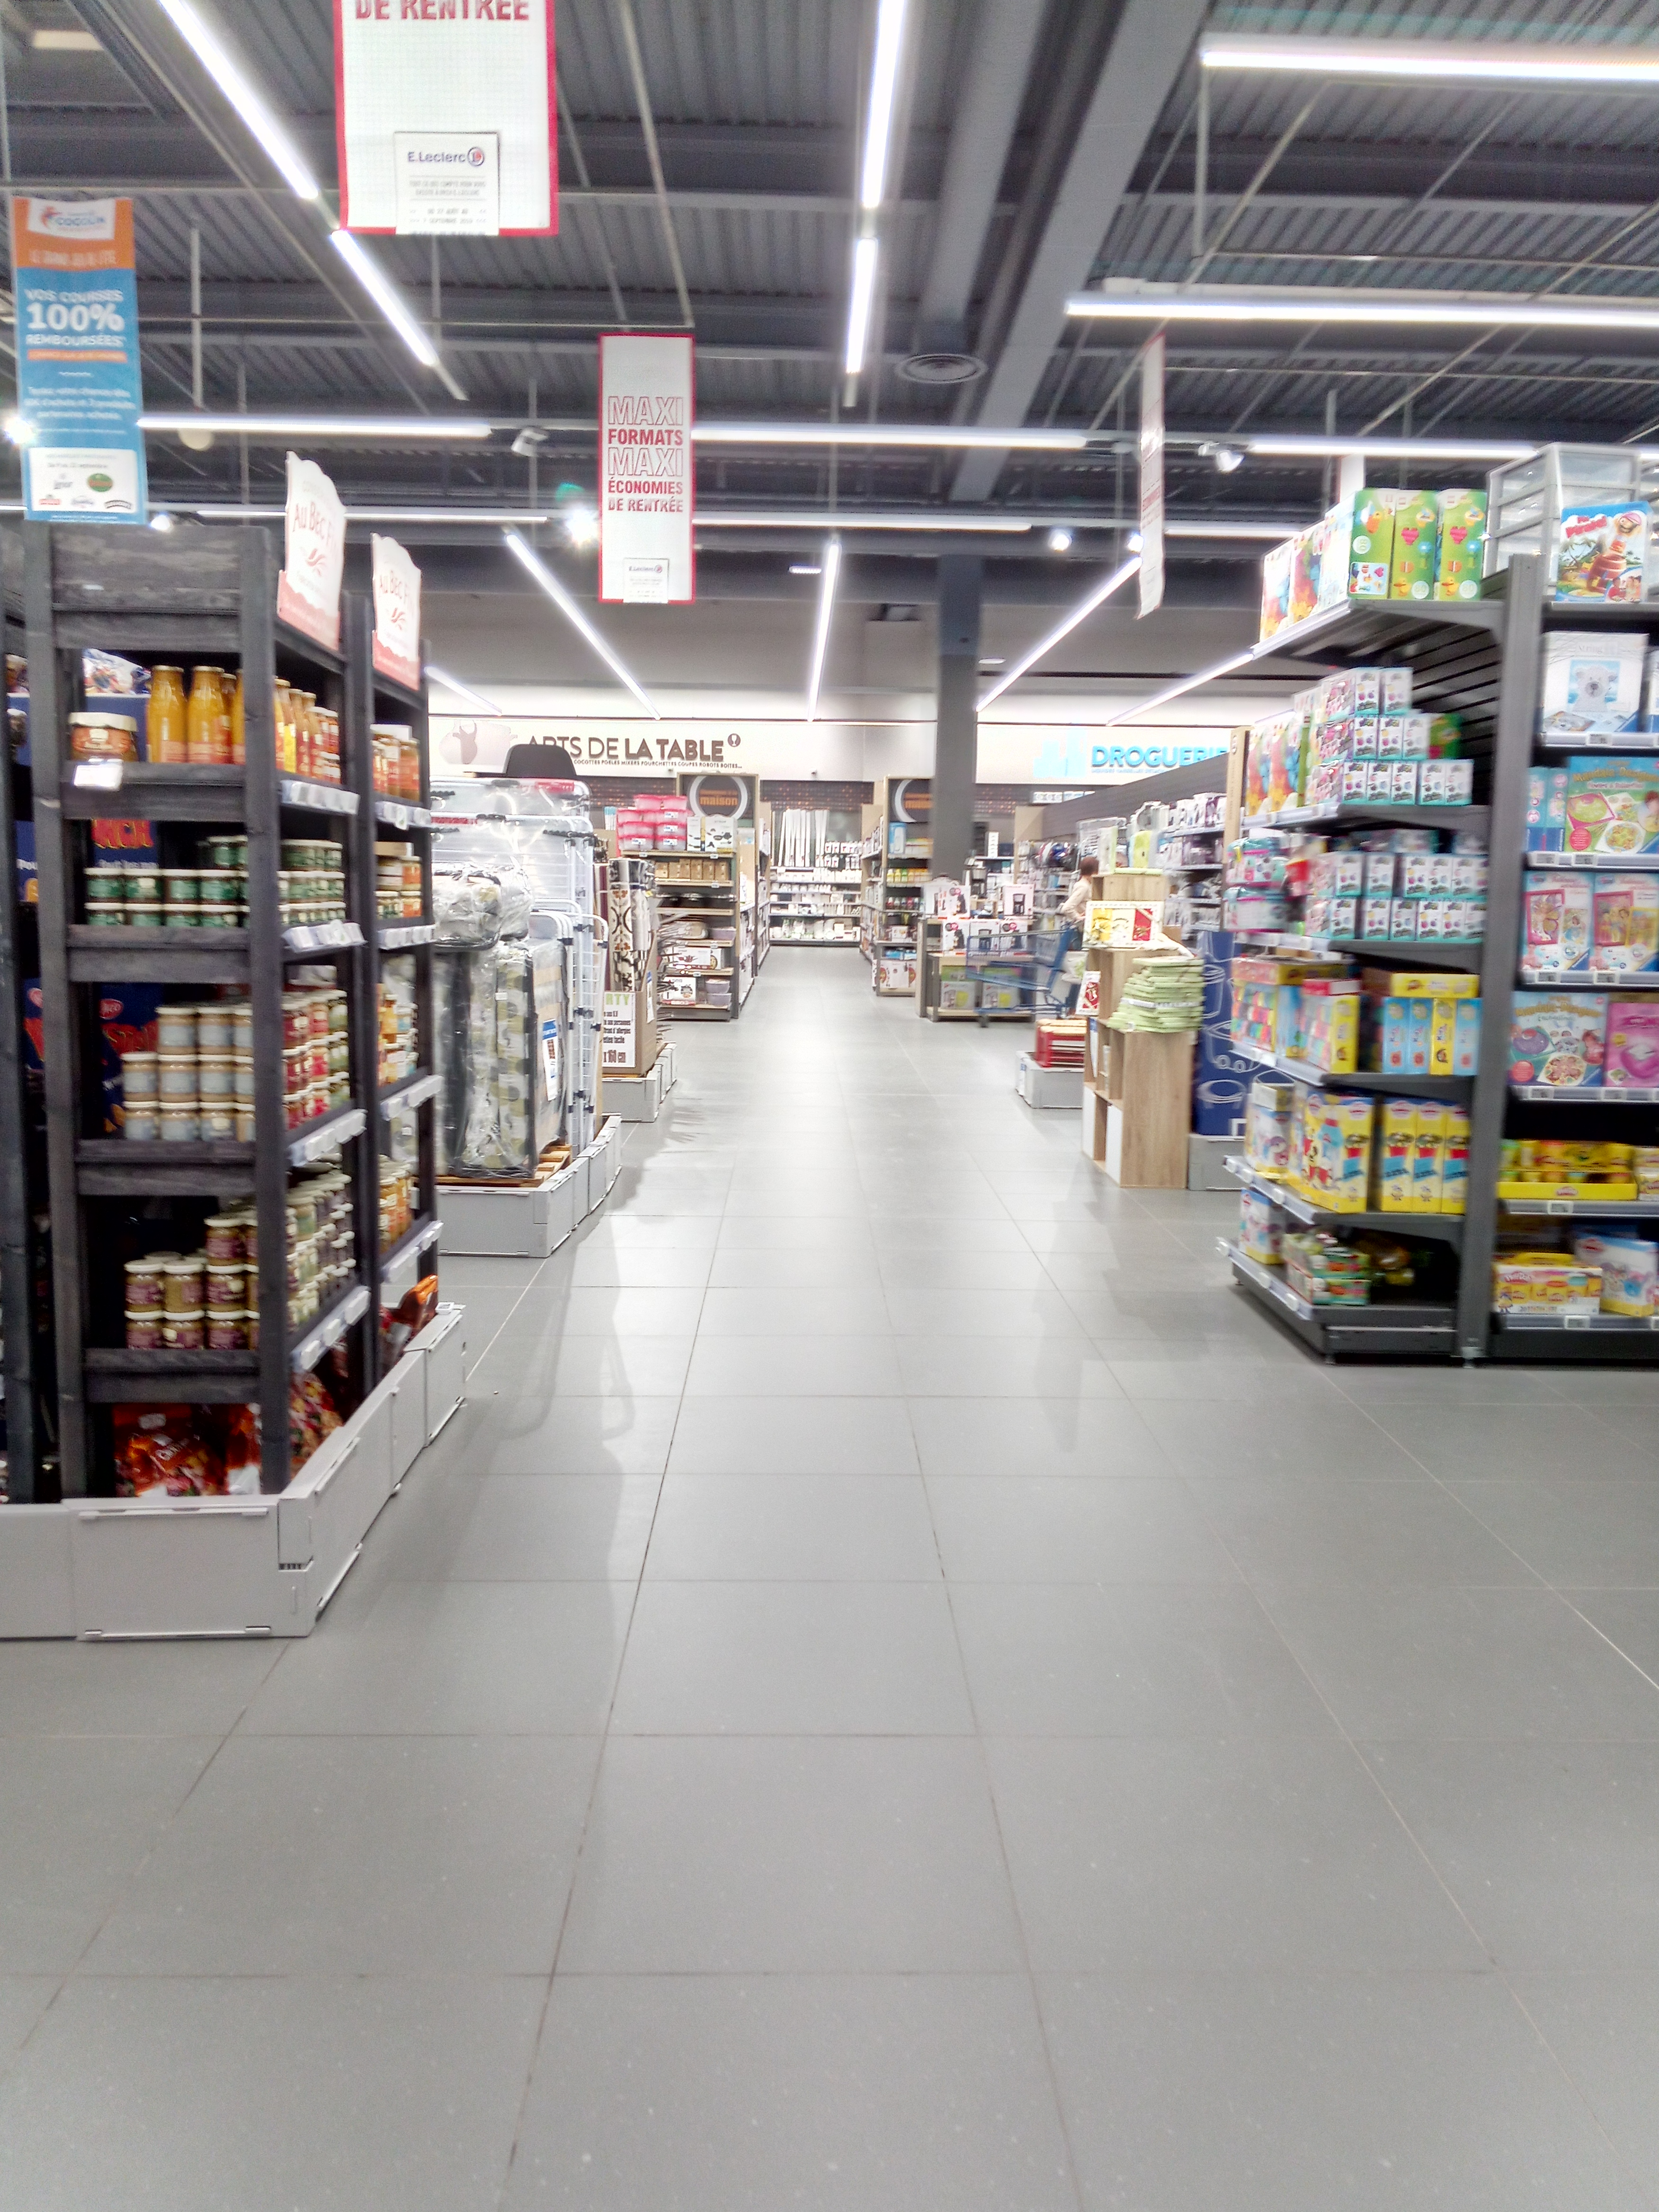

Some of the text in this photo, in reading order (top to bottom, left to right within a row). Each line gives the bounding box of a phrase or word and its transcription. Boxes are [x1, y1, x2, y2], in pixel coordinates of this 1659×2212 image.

[356, 0, 390, 20] DE
[26, 302, 125, 332] 100%
[608, 396, 683, 426] MAXI
[608, 428, 683, 446] FORMATS
[608, 447, 683, 477] MAXI
[608, 477, 683, 494] ÉCONOMIES
[608, 496, 683, 512] DE RENTRÉE
[589, 737, 620, 758] DE
[625, 738, 653, 760] LA
[657, 739, 724, 761] TABLE
[700, 795, 738, 806] maison
